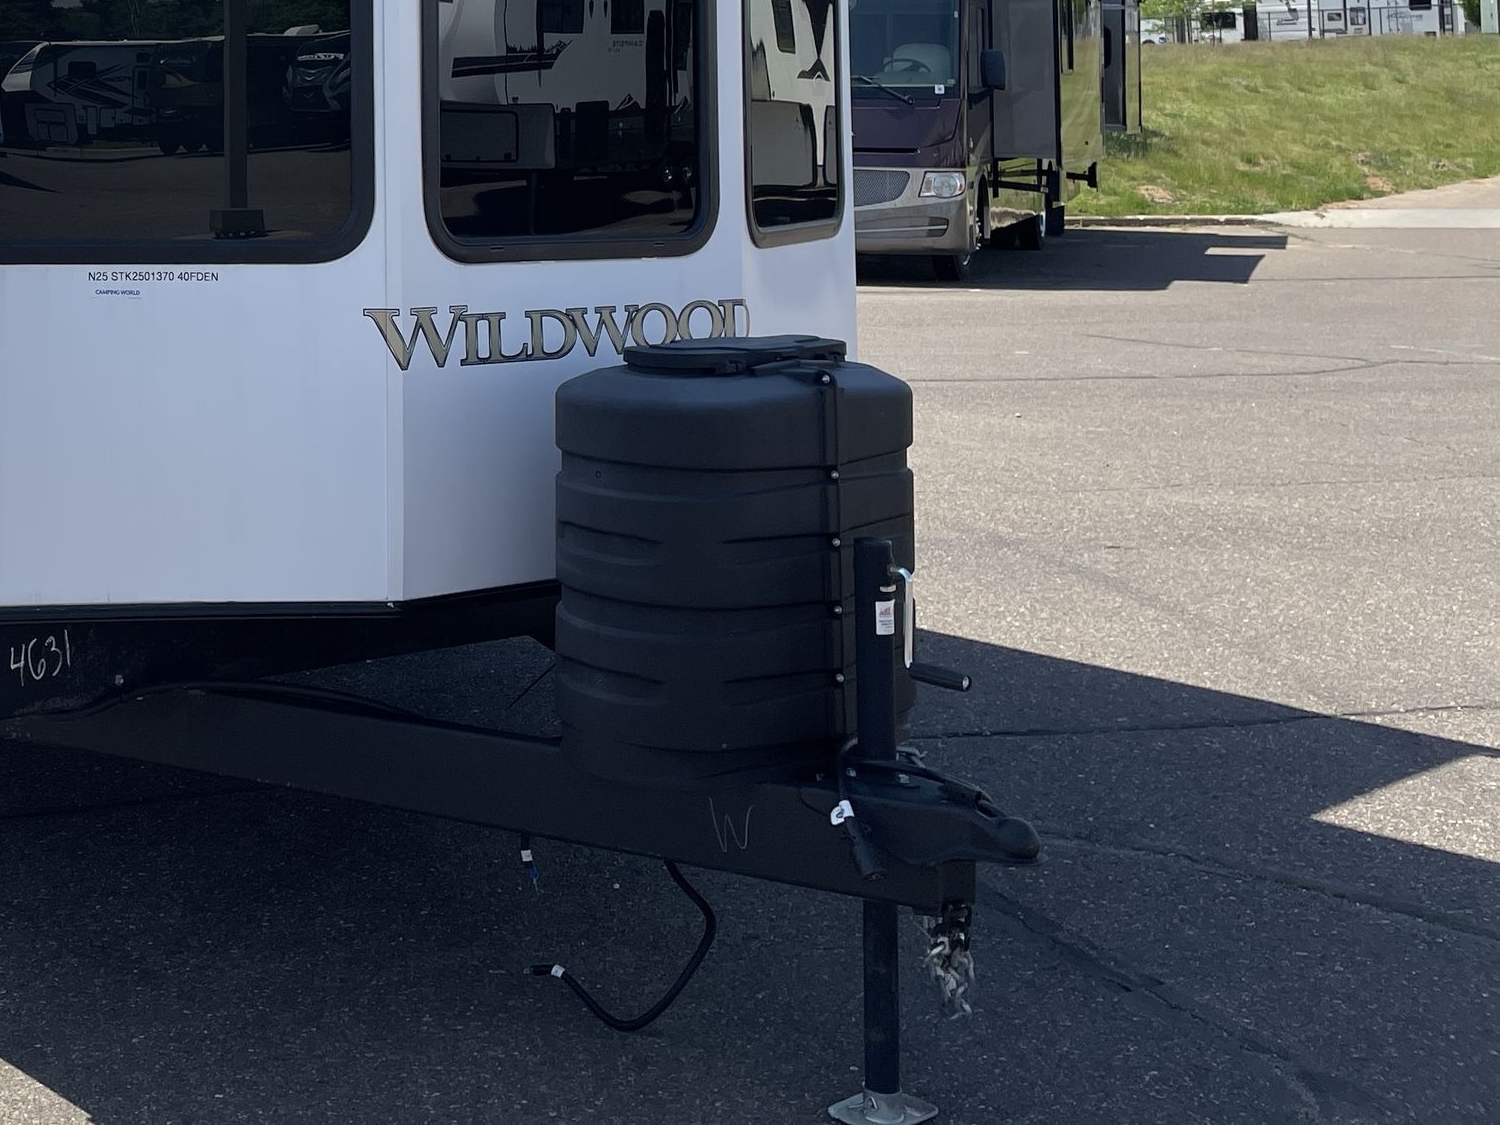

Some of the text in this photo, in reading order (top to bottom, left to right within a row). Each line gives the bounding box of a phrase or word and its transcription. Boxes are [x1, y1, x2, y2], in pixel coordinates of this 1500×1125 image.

[88, 271, 219, 282] N25 STK2501370 40FDEN
[10, 628, 71, 687] 4631
